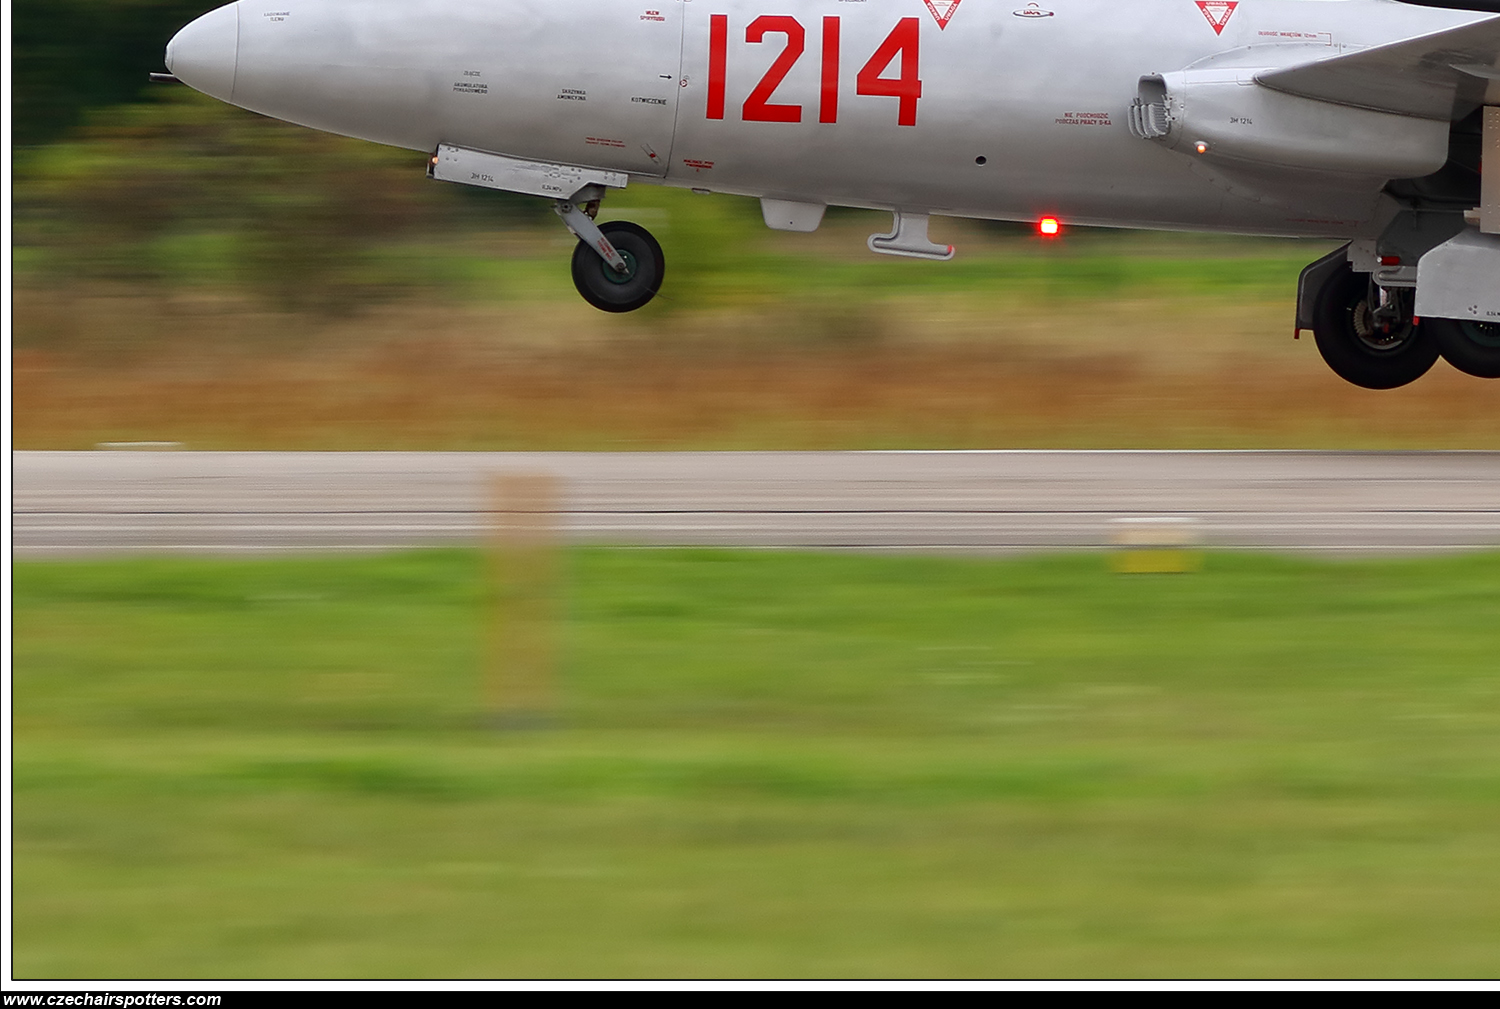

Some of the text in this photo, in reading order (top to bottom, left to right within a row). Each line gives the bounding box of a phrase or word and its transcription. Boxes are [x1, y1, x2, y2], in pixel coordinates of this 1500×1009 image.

[944, 2, 958, 21] UWAGA
[706, 14, 922, 127] 1214
[631, 96, 667, 105] KOTWICZENIE
[1240, 117, 1253, 125] 1214
[481, 173, 494, 182] 1214
